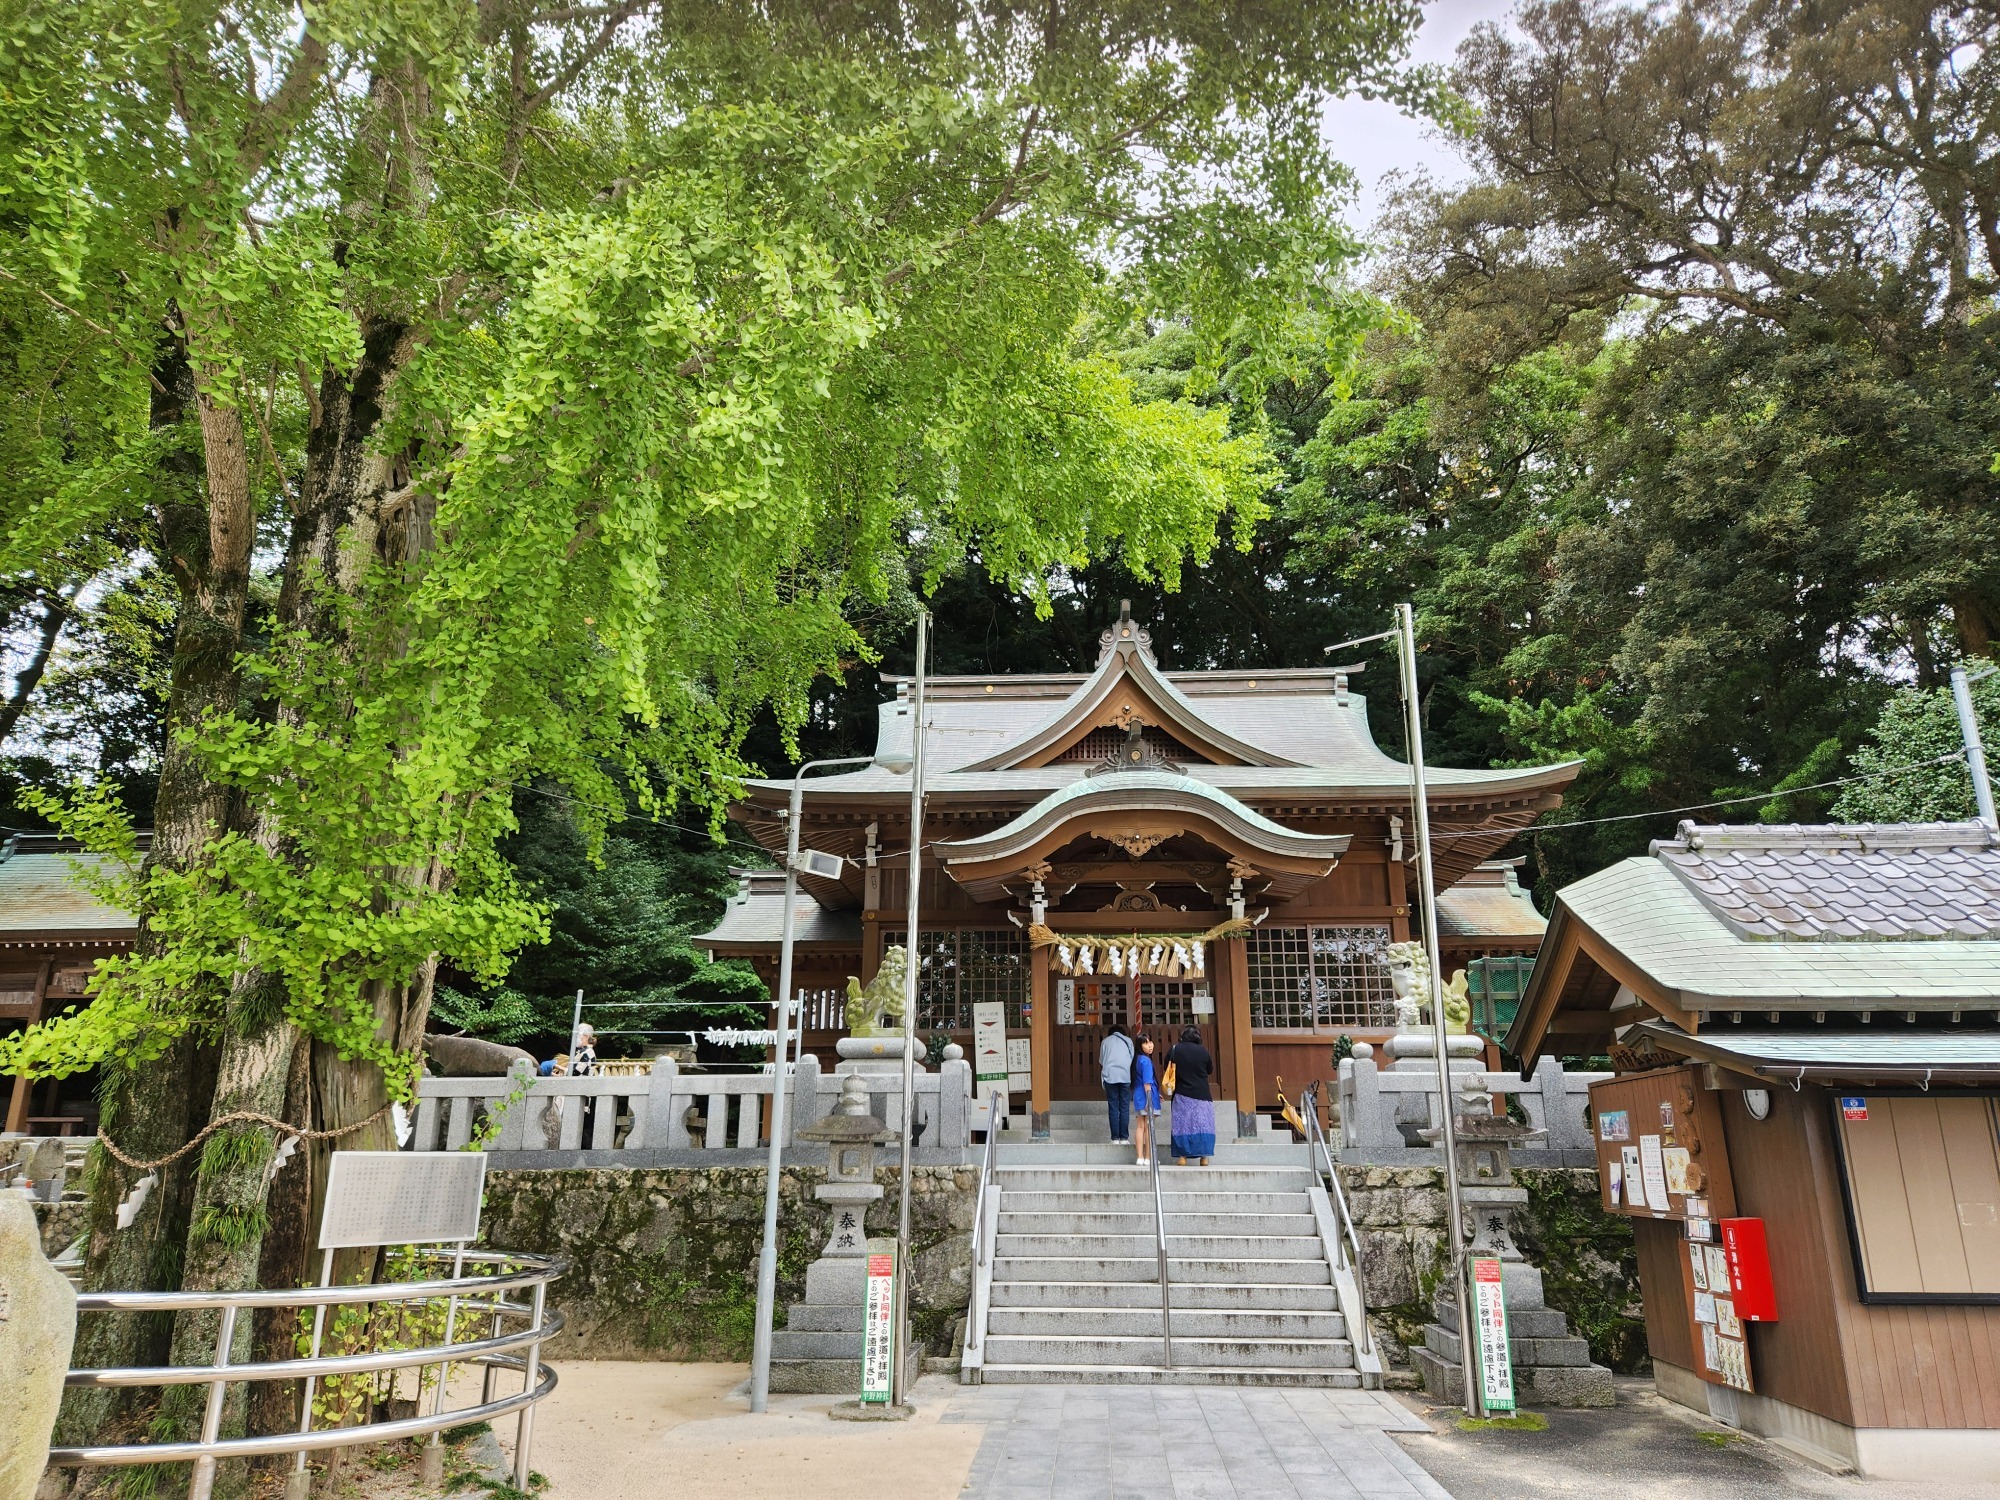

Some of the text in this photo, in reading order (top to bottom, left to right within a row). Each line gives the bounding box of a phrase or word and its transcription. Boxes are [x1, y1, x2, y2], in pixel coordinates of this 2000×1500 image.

[837, 1211, 856, 1248] 奉納
[1487, 1215, 1509, 1252] 奉納
[878, 1278, 891, 1381] ペット同伴での参道や拝殿
[1491, 1284, 1509, 1388] ペット同伴での参道や拝殿
[863, 1391, 889, 1400] 平野神社
[1485, 1400, 1515, 1409] 平野神社
